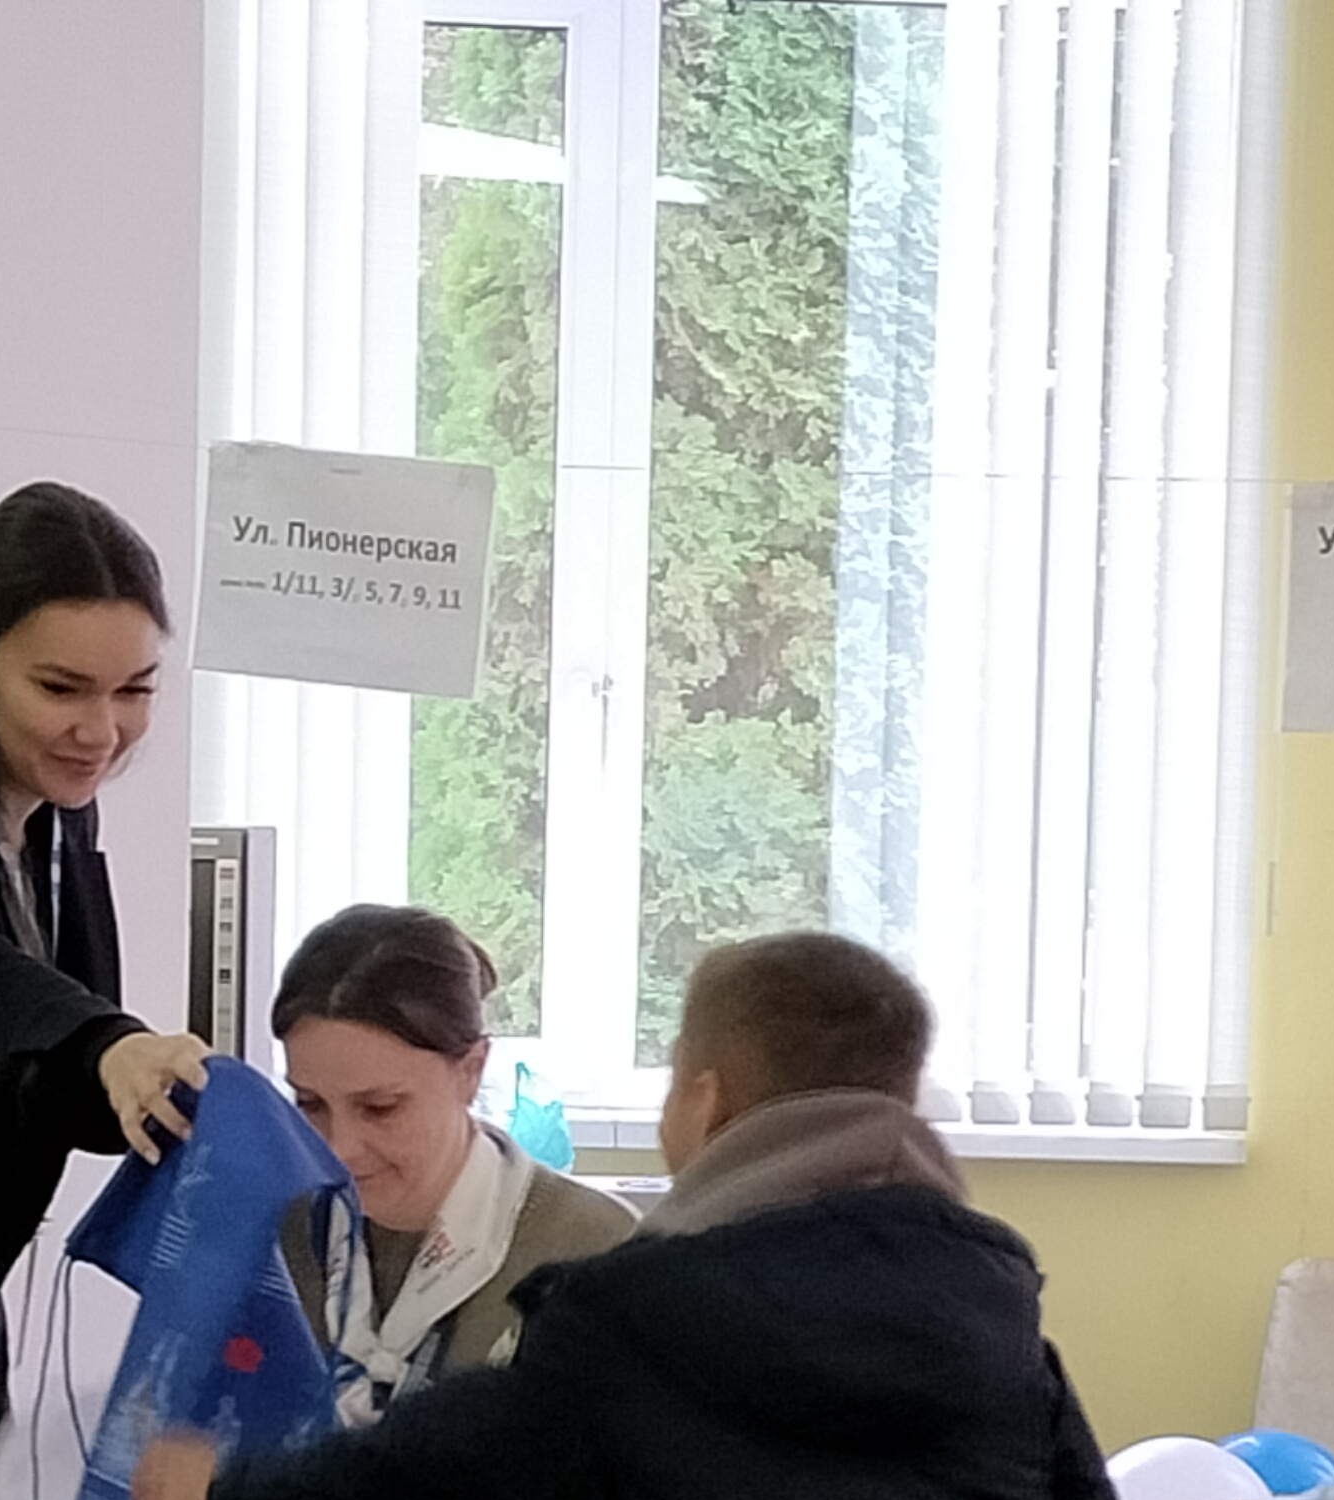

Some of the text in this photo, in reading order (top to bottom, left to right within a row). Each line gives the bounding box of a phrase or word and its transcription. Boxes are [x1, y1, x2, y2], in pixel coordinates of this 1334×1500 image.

[233, 516, 457, 563] Ул. Пионерская
[271, 571, 324, 599] 1/11,
[365, 581, 383, 604] 5,
[389, 583, 407, 607] 7,
[413, 587, 431, 610] 9,
[437, 589, 462, 609] 11
